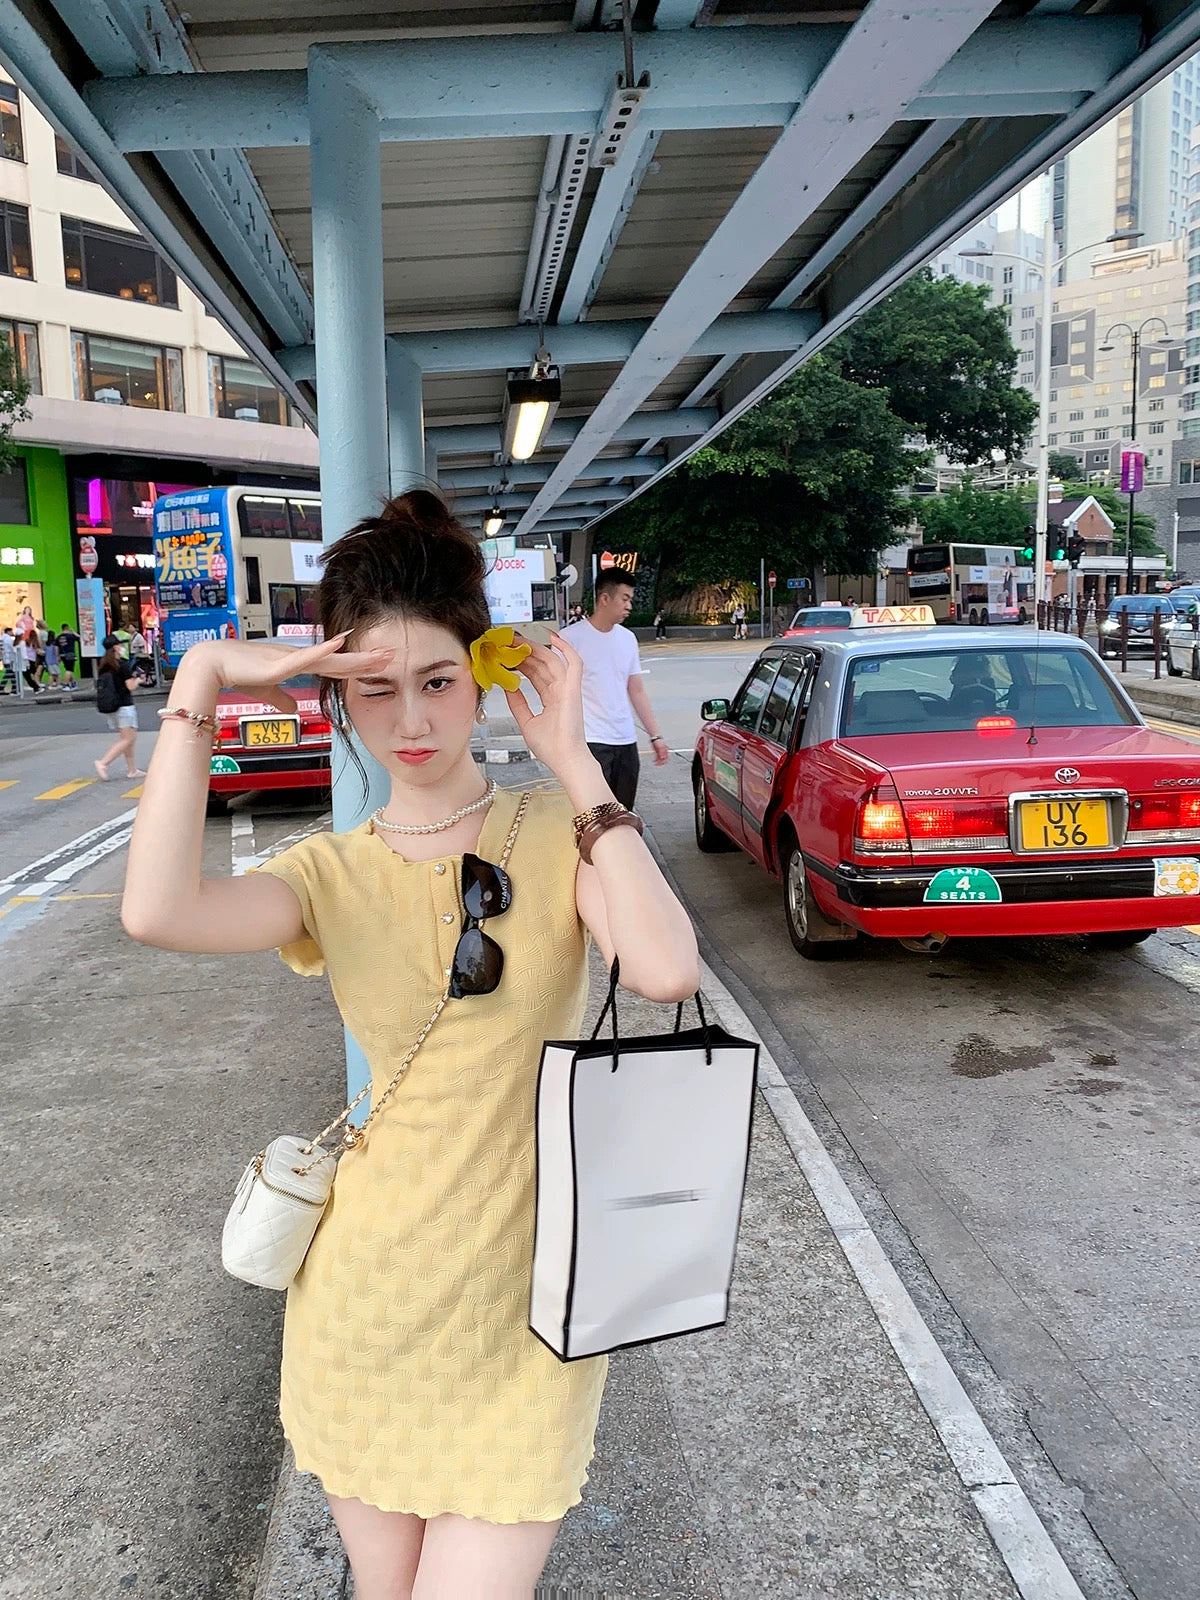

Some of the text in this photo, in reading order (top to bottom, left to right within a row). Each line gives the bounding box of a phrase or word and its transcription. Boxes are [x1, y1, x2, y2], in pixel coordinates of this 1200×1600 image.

[504, 559, 525, 569] OCBC
[861, 606, 928, 624] TAXI
[261, 722, 281, 733] VN
[252, 732, 290, 745] 3637
[1047, 802, 1081, 824] UY
[1042, 823, 1088, 848] 136
[947, 867, 980, 877] TAXI
[955, 876, 971, 890] 4
[500, 875, 508, 909] CHANEL
[940, 891, 986, 900] SEATS
